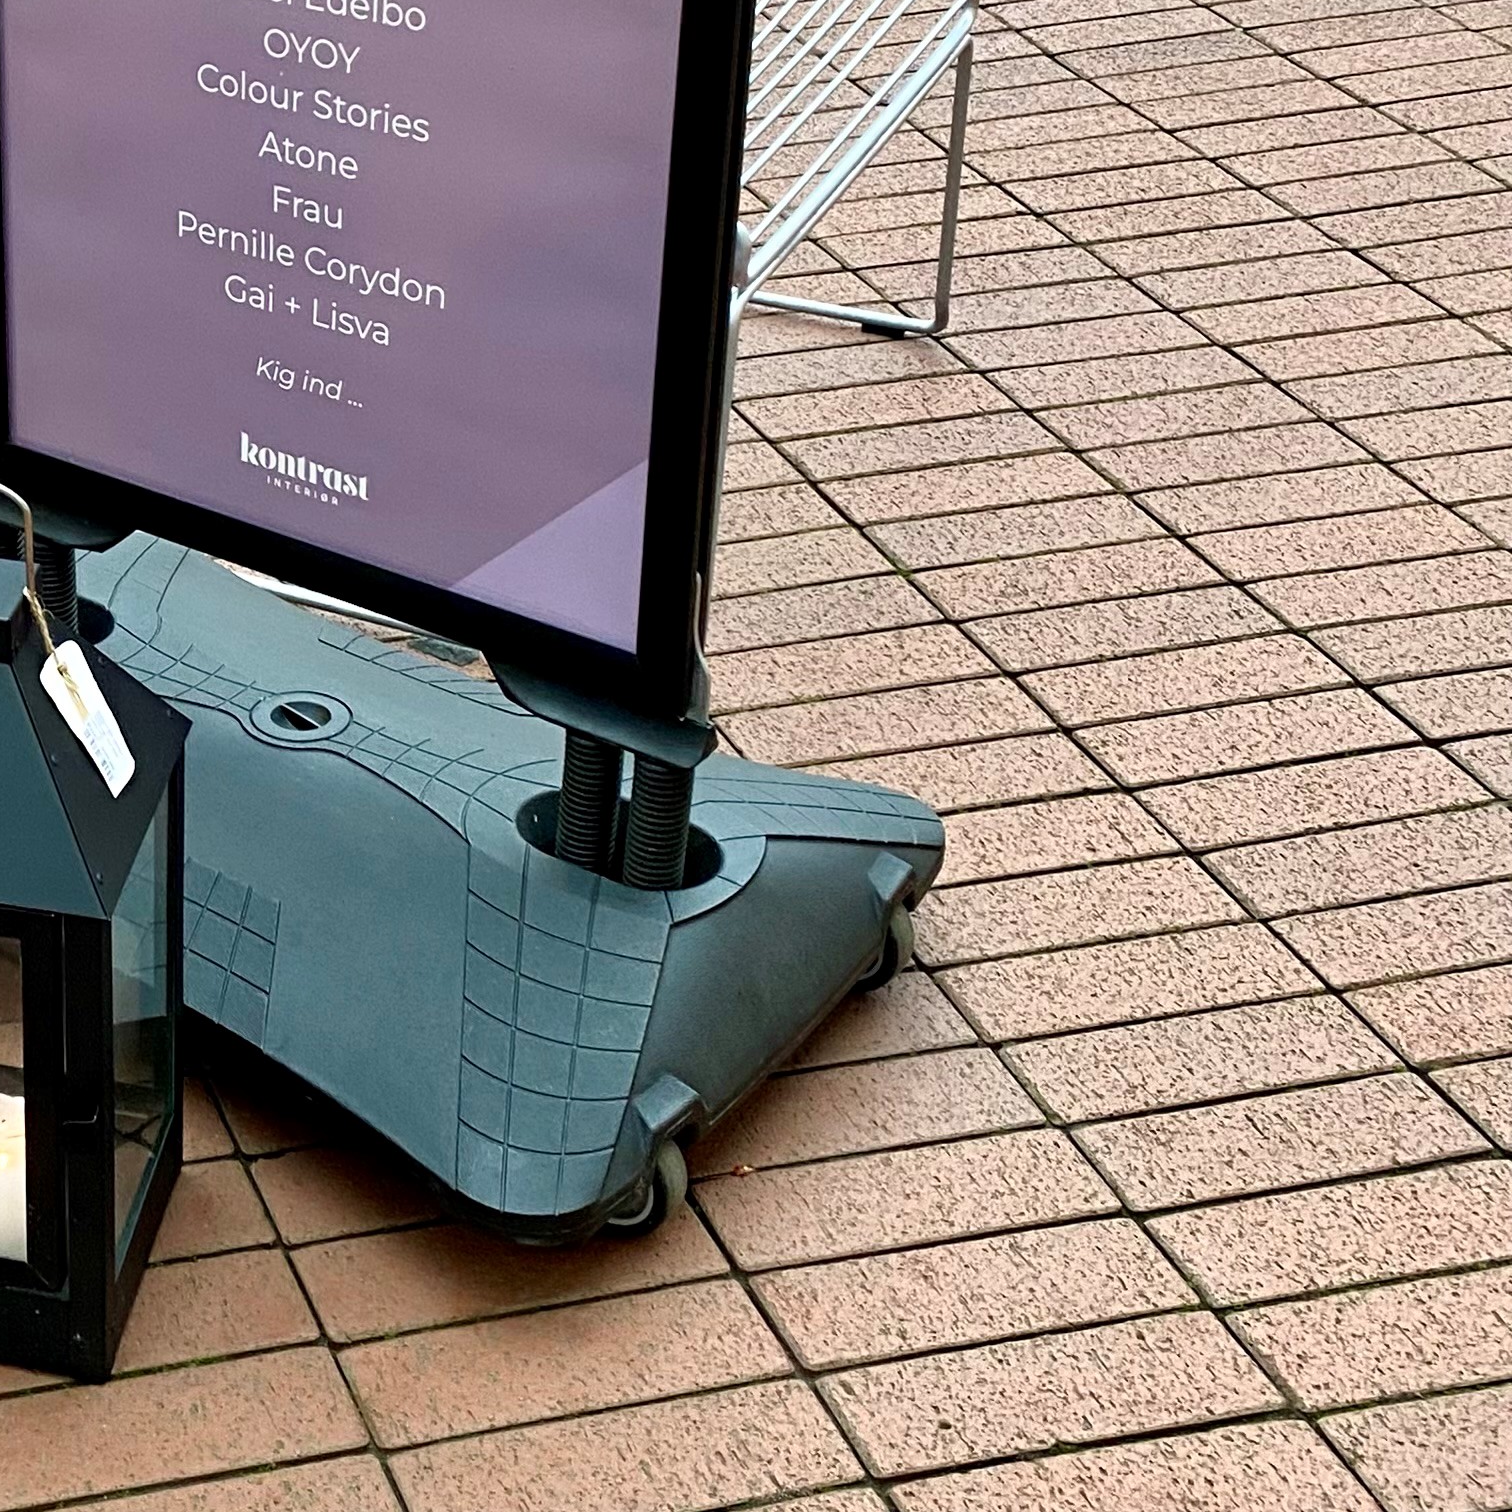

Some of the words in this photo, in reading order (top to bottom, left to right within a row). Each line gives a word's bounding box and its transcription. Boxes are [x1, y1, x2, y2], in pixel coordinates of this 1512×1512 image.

[263, 28, 361, 74] OYOY
[197, 63, 305, 113] Colour
[312, 89, 430, 143] Stories
[257, 131, 359, 180] Atone
[273, 184, 343, 230] Frau
[178, 210, 295, 267] Pernille
[304, 246, 446, 310] Corydon
[224, 274, 274, 313] Gai
[284, 296, 301, 315] +
[312, 297, 390, 347] Lisva
[256, 356, 296, 390] Kig
[302, 369, 344, 401] ind
[240, 431, 370, 502] kontrast
[266, 475, 339, 506] INTERIØR
